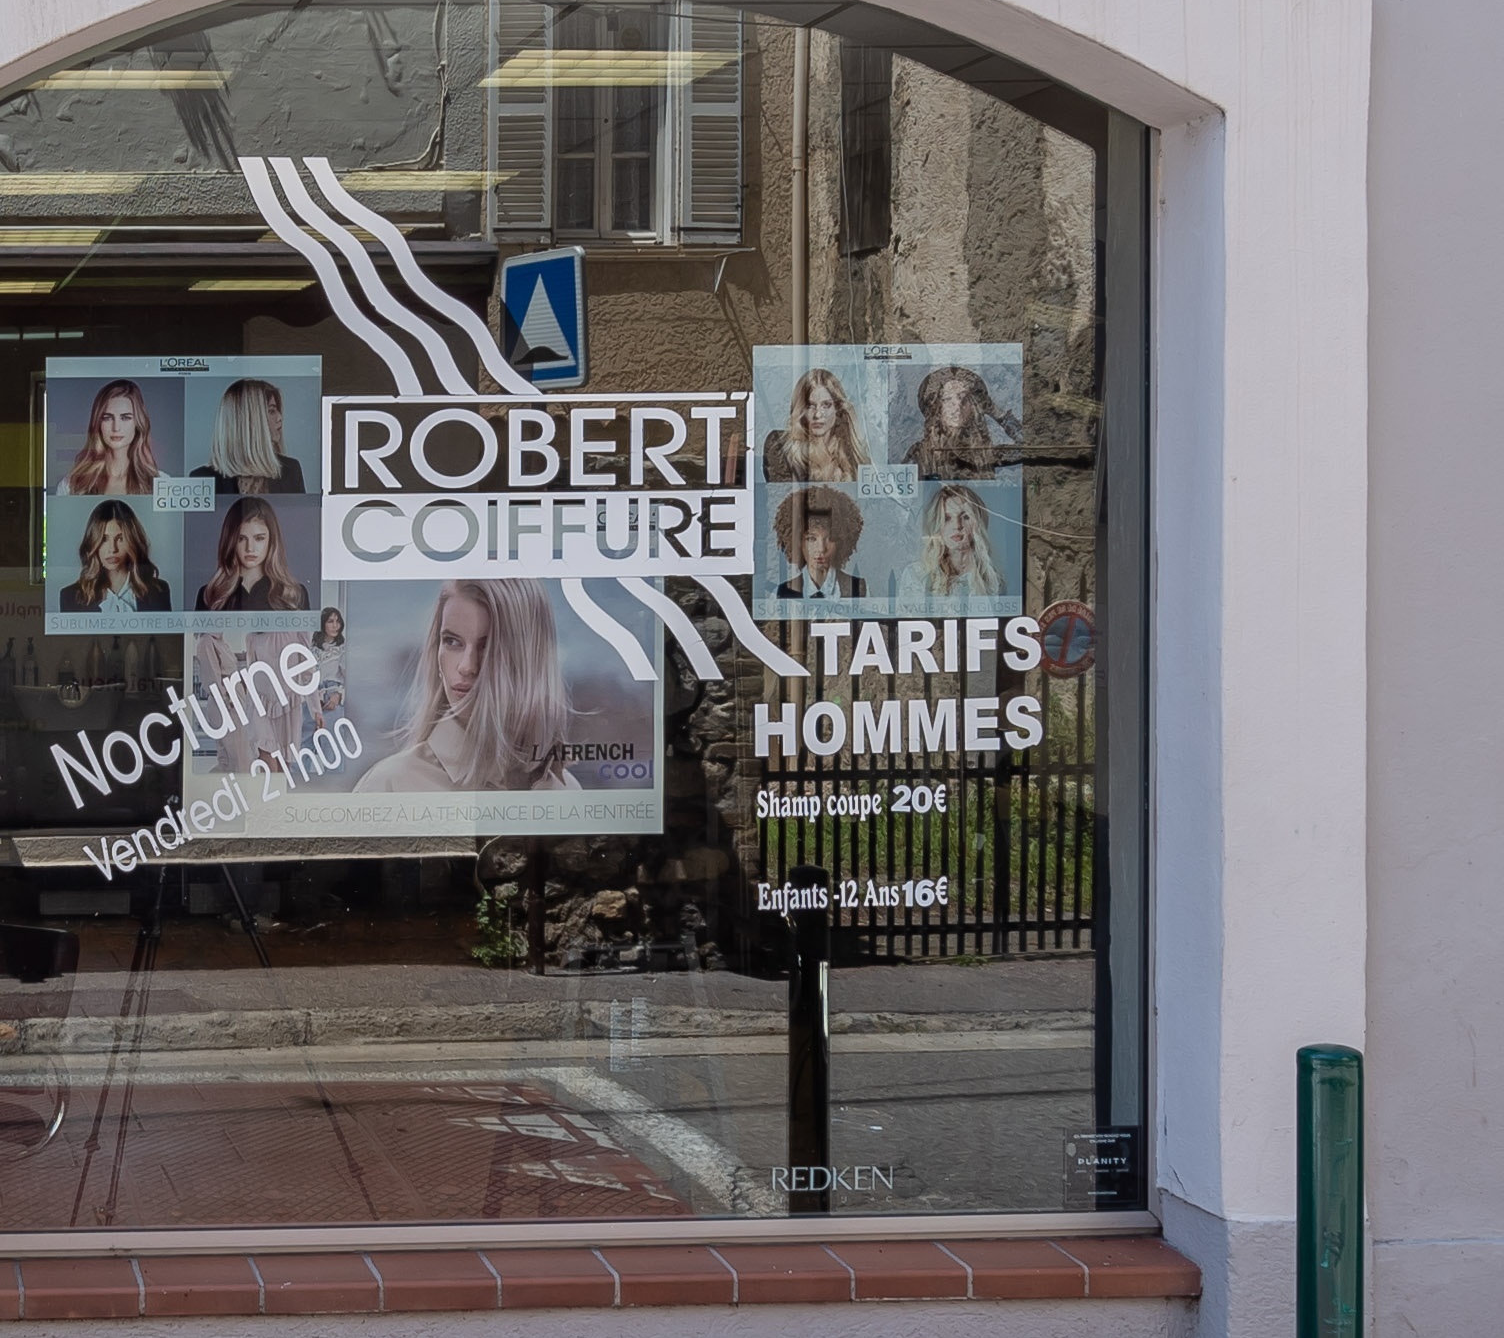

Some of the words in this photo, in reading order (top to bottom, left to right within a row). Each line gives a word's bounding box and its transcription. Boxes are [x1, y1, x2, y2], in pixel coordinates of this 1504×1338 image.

[344, 407, 737, 489] ROBERT
[861, 466, 914, 483] French
[157, 480, 211, 496] French
[861, 484, 914, 495] GLOSS
[157, 497, 211, 509] GLOSS
[341, 496, 736, 562] COIFFURE
[50, 616, 116, 630] SUBLIMEZ
[120, 616, 161, 629] VOTRE
[167, 616, 232, 628] BALAYAGE
[274, 616, 317, 628] GLOSS
[810, 616, 1042, 676] TARIFS
[49, 642, 322, 809] Nocturne
[754, 695, 1043, 757] HOMMES
[599, 760, 653, 780] cool
[82, 772, 250, 881] Vendredi
[250, 717, 363, 802] 21h00
[285, 806, 392, 823] SUCCOMBEZ
[412, 806, 433, 821] LA
[437, 805, 528, 821] TENDANCE
[532, 805, 554, 821] DE
[559, 804, 580, 820] LA
[584, 801, 655, 820] RENTRÉE
[756, 790, 821, 823] Shamp
[826, 793, 882, 821] coupe
[891, 784, 947, 813] 20€
[757, 881, 829, 917] Enfants
[833, 880, 859, 908] -12
[863, 879, 899, 907] Ans
[901, 876, 949, 907] 16€
[1077, 1157, 1127, 1165] PLANITY
[771, 1165, 894, 1191] REDKEN
